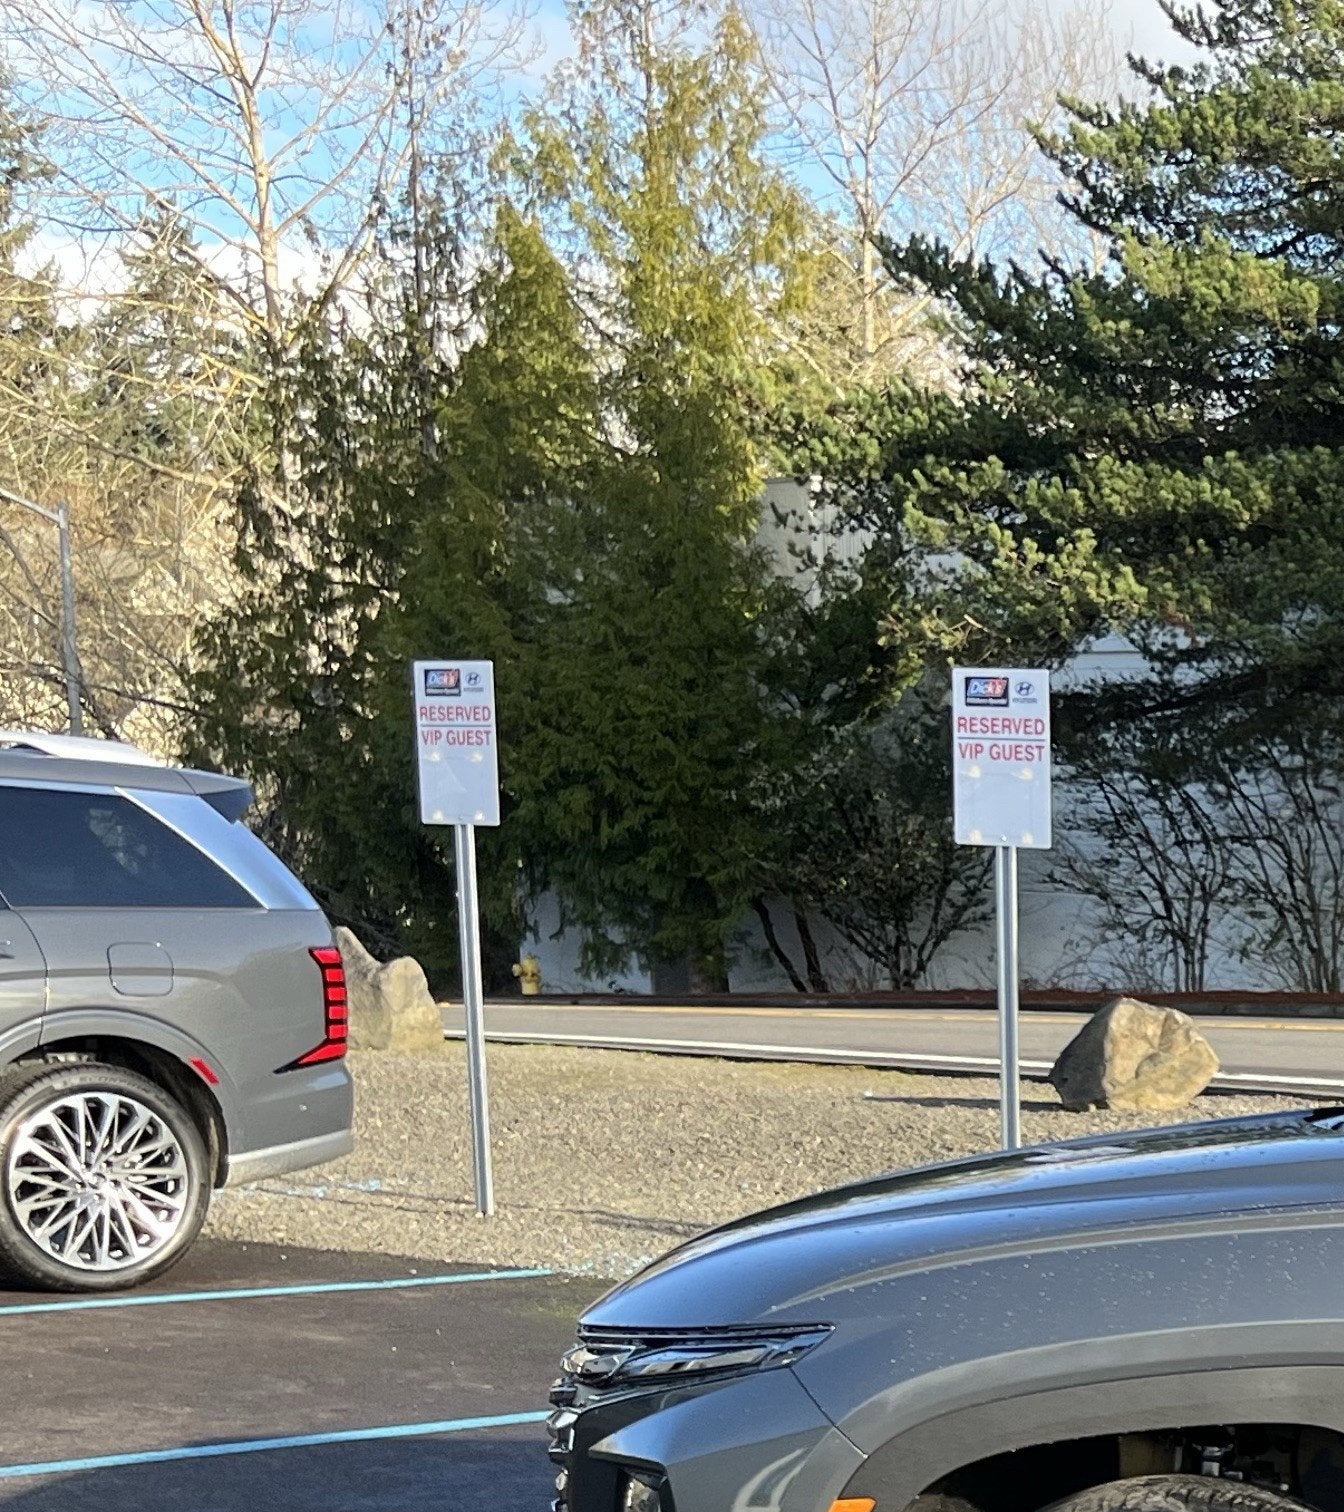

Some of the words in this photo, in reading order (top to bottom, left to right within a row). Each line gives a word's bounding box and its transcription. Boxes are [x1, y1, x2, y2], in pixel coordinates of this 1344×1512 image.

[419, 705, 491, 722] RESERVED
[957, 716, 1045, 736] RESERVED
[421, 730, 442, 746] VIP
[446, 730, 492, 746] GUEST
[958, 743, 984, 760] VIP
[989, 743, 1045, 762] GUEST
